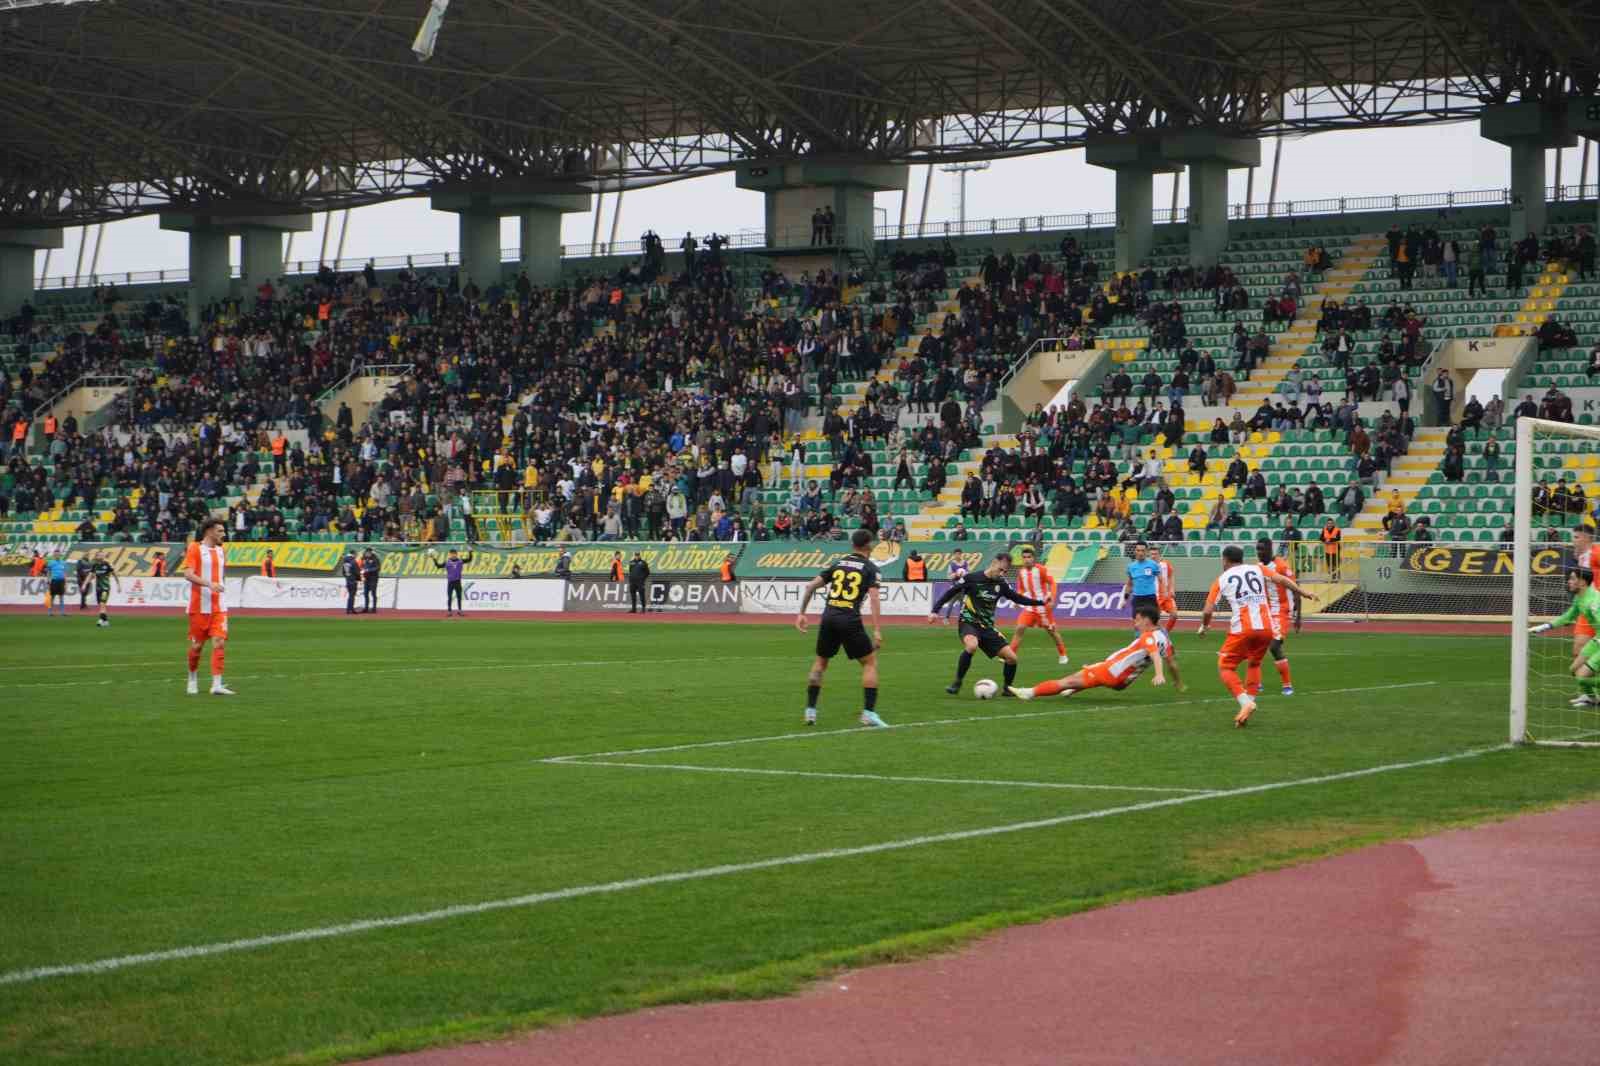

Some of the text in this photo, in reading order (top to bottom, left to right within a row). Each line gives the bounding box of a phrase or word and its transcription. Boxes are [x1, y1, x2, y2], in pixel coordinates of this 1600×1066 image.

[1469, 341, 1479, 352] K
[1584, 400, 1594, 411] K
[1375, 566, 1391, 579] 10
[830, 568, 862, 600] 33
[1228, 571, 1262, 600] 26
